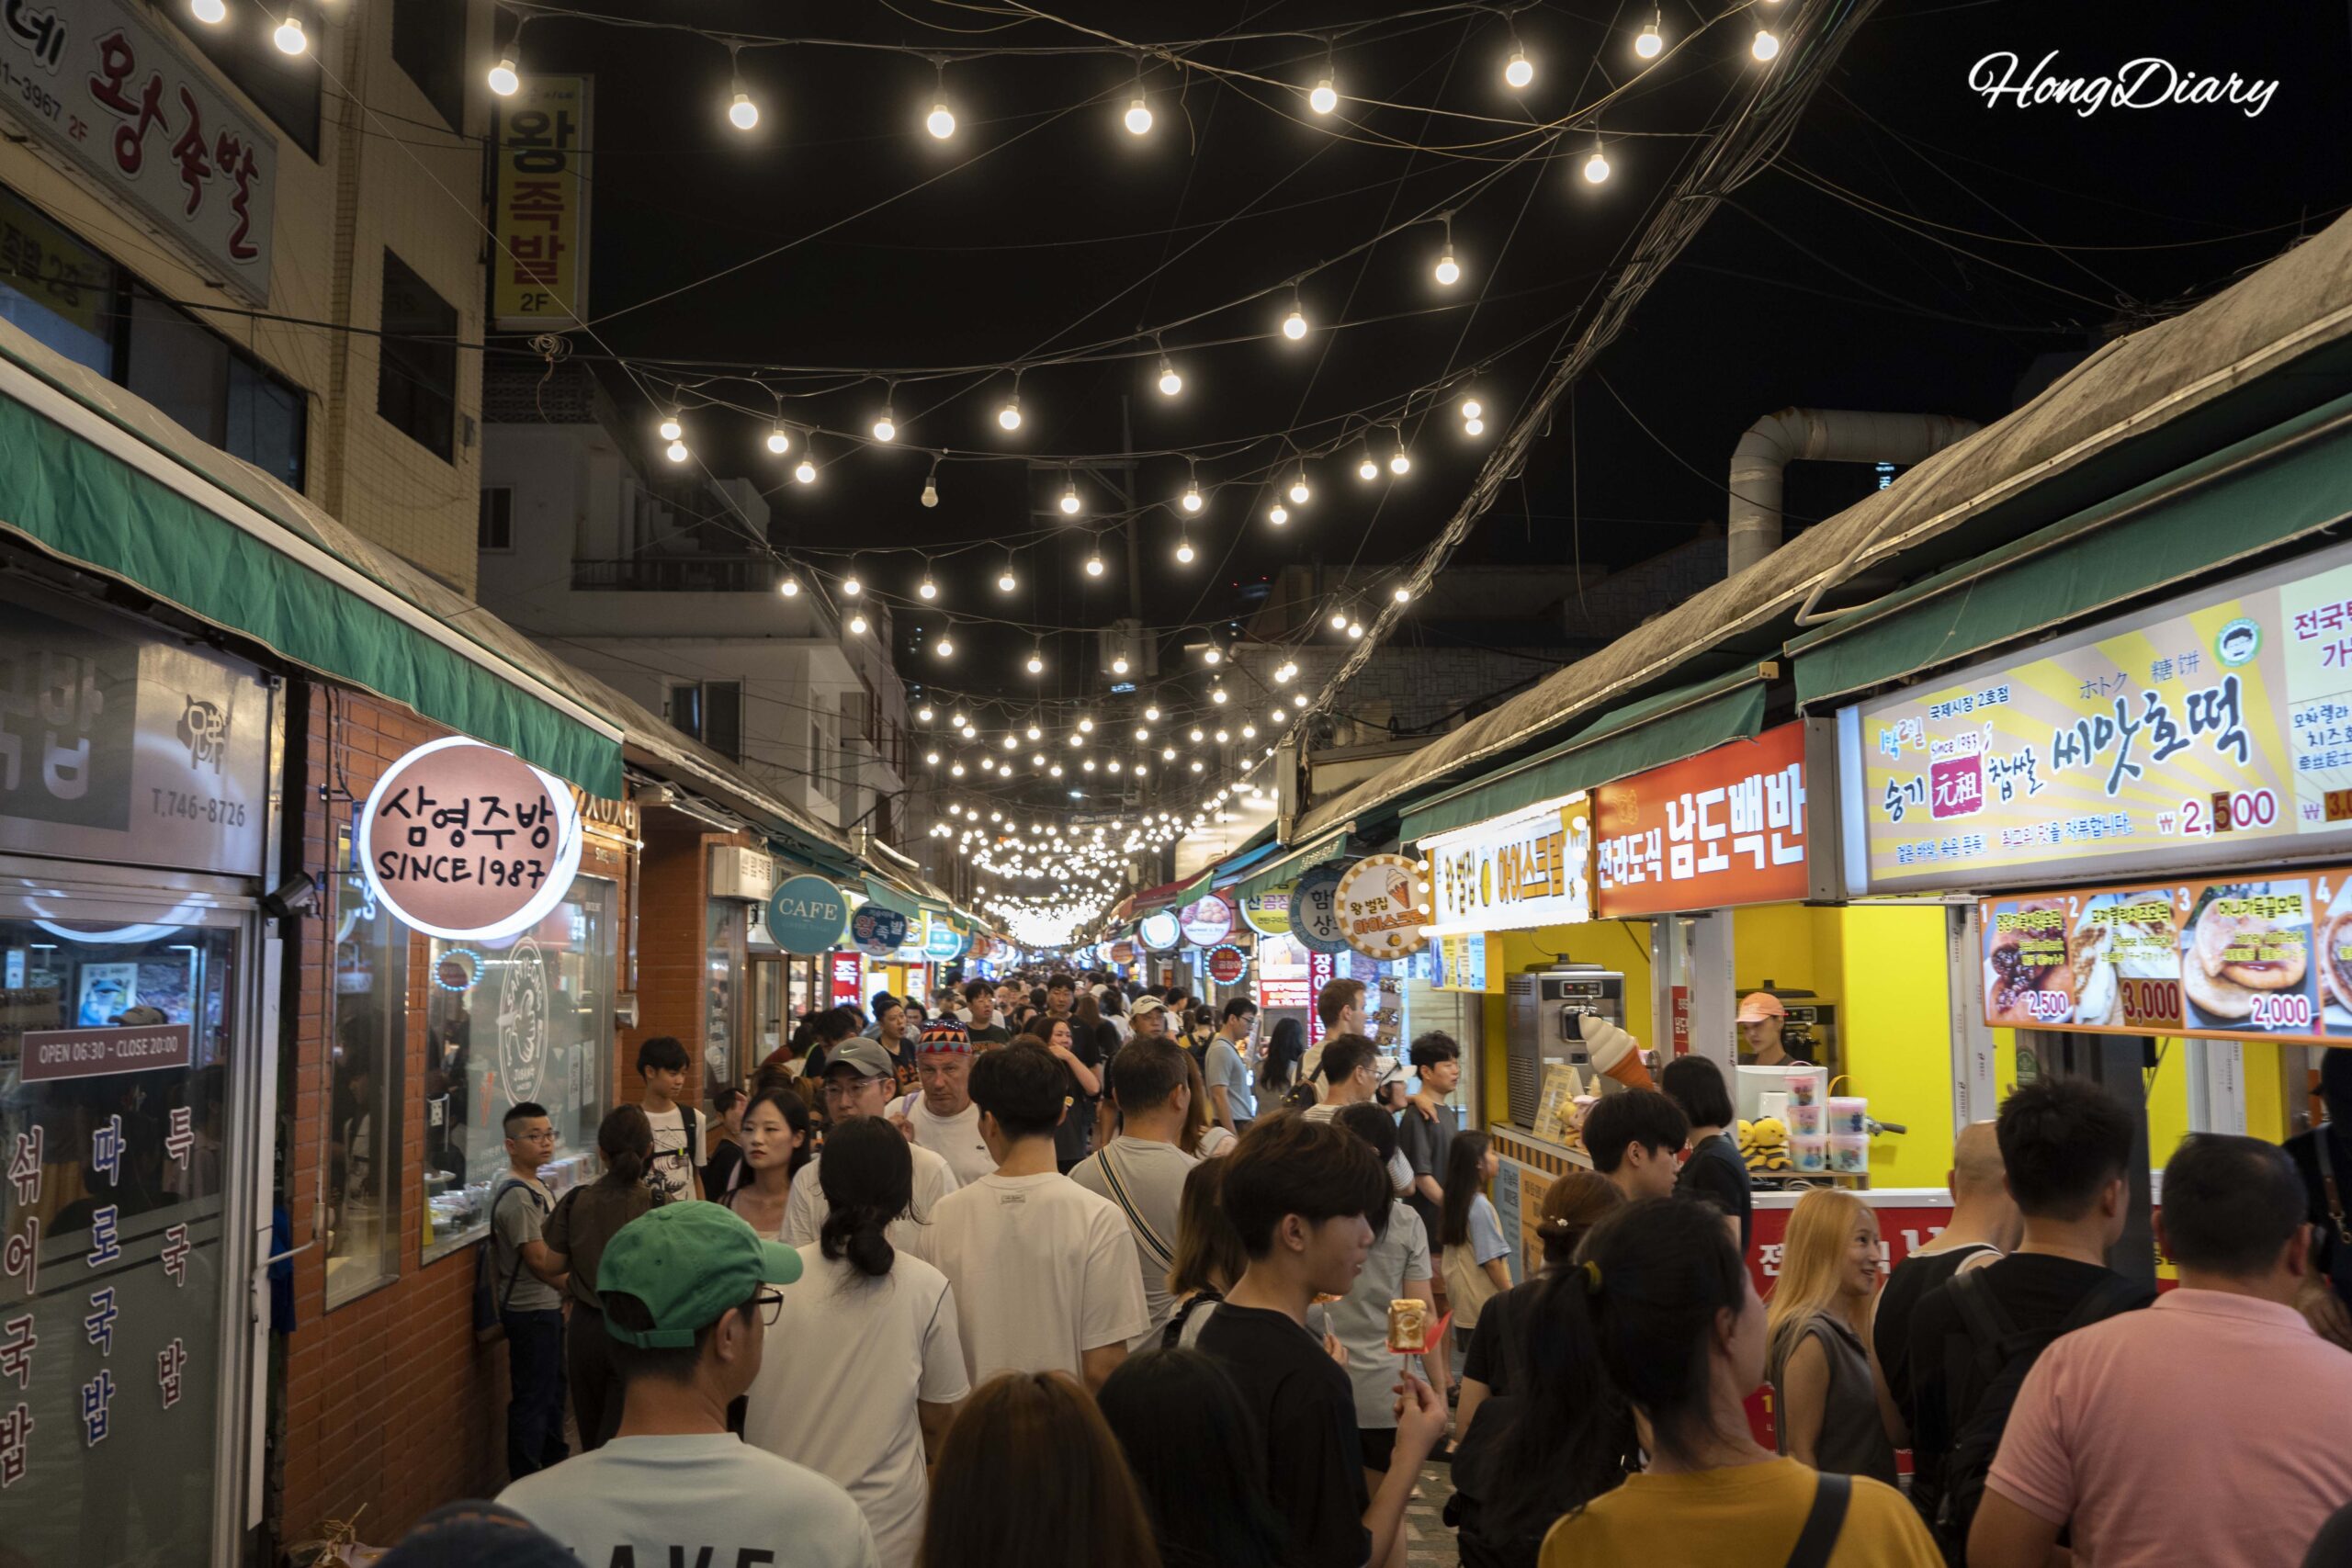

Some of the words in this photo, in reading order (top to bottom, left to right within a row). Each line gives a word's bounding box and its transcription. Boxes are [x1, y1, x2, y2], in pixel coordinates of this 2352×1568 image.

[68, 115, 89, 141] 2F
[89, 33, 260, 259] 왕족발
[507, 109, 575, 286] 왕족발
[519, 293, 549, 312] 2F
[1929, 696, 1973, 721] 국제시장
[1977, 685, 2009, 707] 2호점
[1988, 747, 2043, 801] 찹쌀
[2053, 675, 2247, 795] 씨앗호떡
[1934, 771, 1980, 807] 元祖
[152, 788, 245, 827] T.746-8726
[381, 785, 553, 850] 삼영주방
[2183, 790, 2275, 838] 2,500
[1598, 828, 1663, 889] 전라도식
[1666, 763, 1806, 880] 남도백반
[379, 851, 471, 884] SINCE
[478, 856, 545, 888] 1987
[1498, 829, 1565, 905] 아이스크림
[778, 897, 839, 921] CAFE
[1980, 903, 1988, 923] 1
[2068, 896, 2080, 918] 2
[2177, 886, 2191, 912] 3
[1352, 908, 1428, 936] 아이스크림
[2029, 992, 2067, 1020] 2,500
[2122, 980, 2181, 1025] 3,000
[2252, 996, 2309, 1028] 2,000
[39, 1043, 71, 1065] OPEN
[73, 1042, 106, 1061] 06:30
[116, 1037, 148, 1057] CLOSE
[150, 1035, 178, 1055] 20:00
[83, 1113, 126, 1447] 따로국밥
